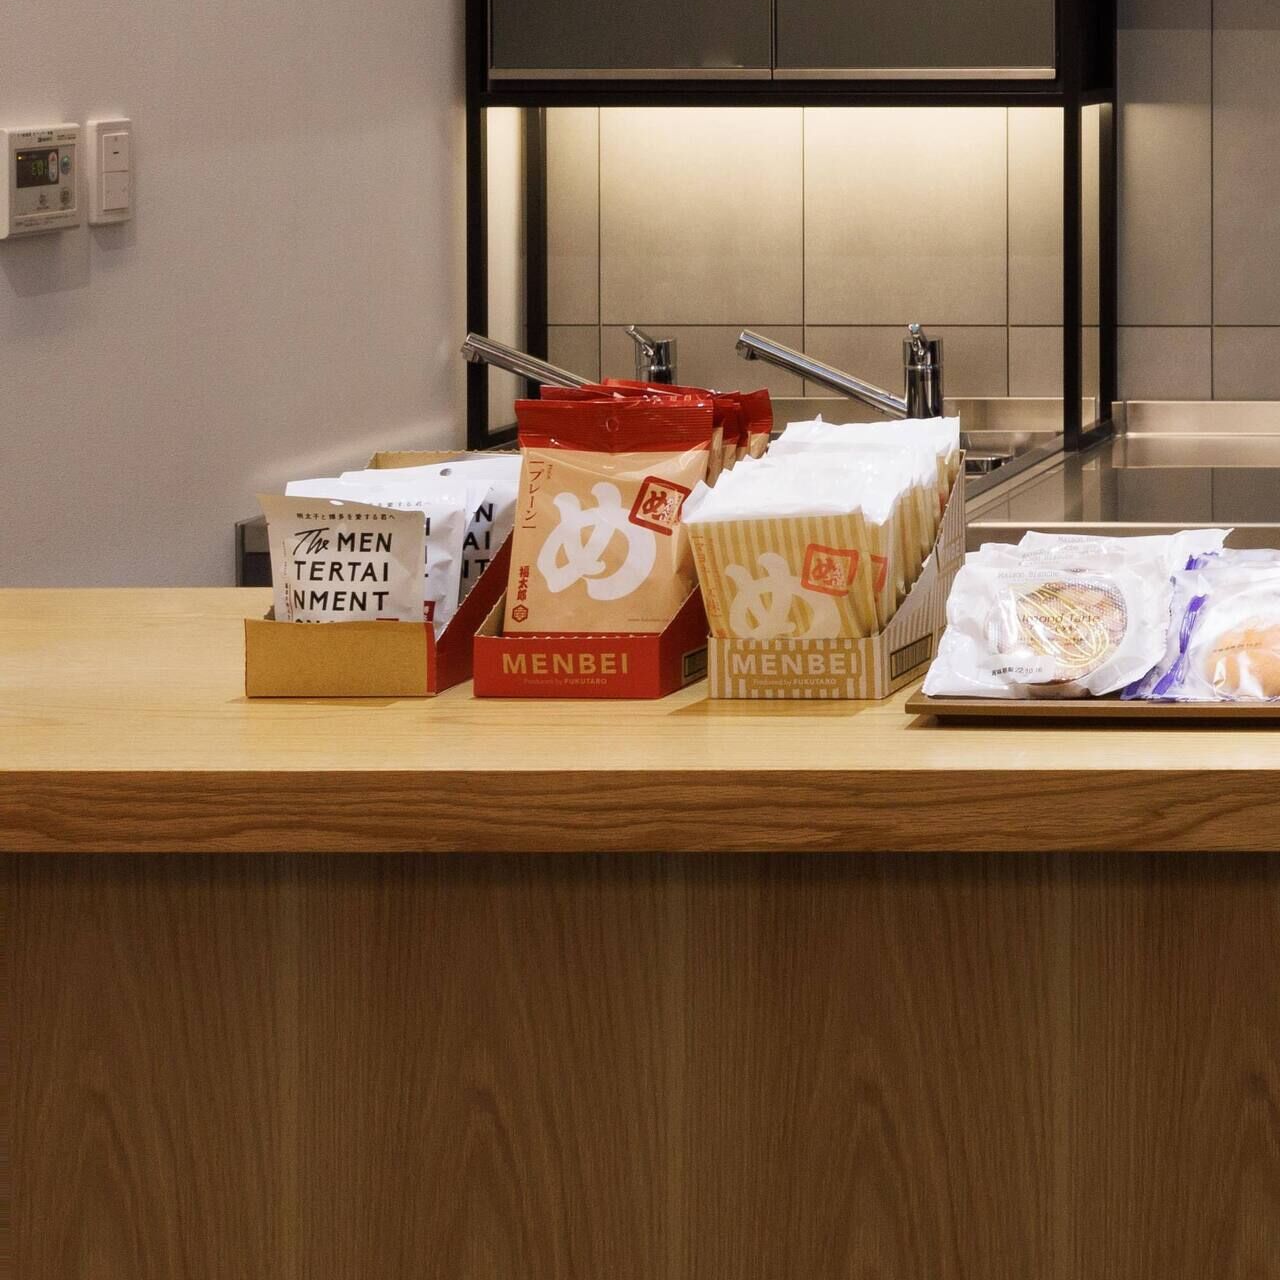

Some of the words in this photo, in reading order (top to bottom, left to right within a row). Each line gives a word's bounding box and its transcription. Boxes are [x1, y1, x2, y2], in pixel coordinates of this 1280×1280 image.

[525, 468, 544, 521] プレーン
[293, 527, 330, 556] The
[337, 532, 392, 553] MEN
[537, 481, 657, 601] め
[294, 560, 389, 582] TERTAI
[293, 589, 390, 612] NMENT
[502, 653, 629, 675] MENBEI
[732, 653, 857, 675] MENBEI
